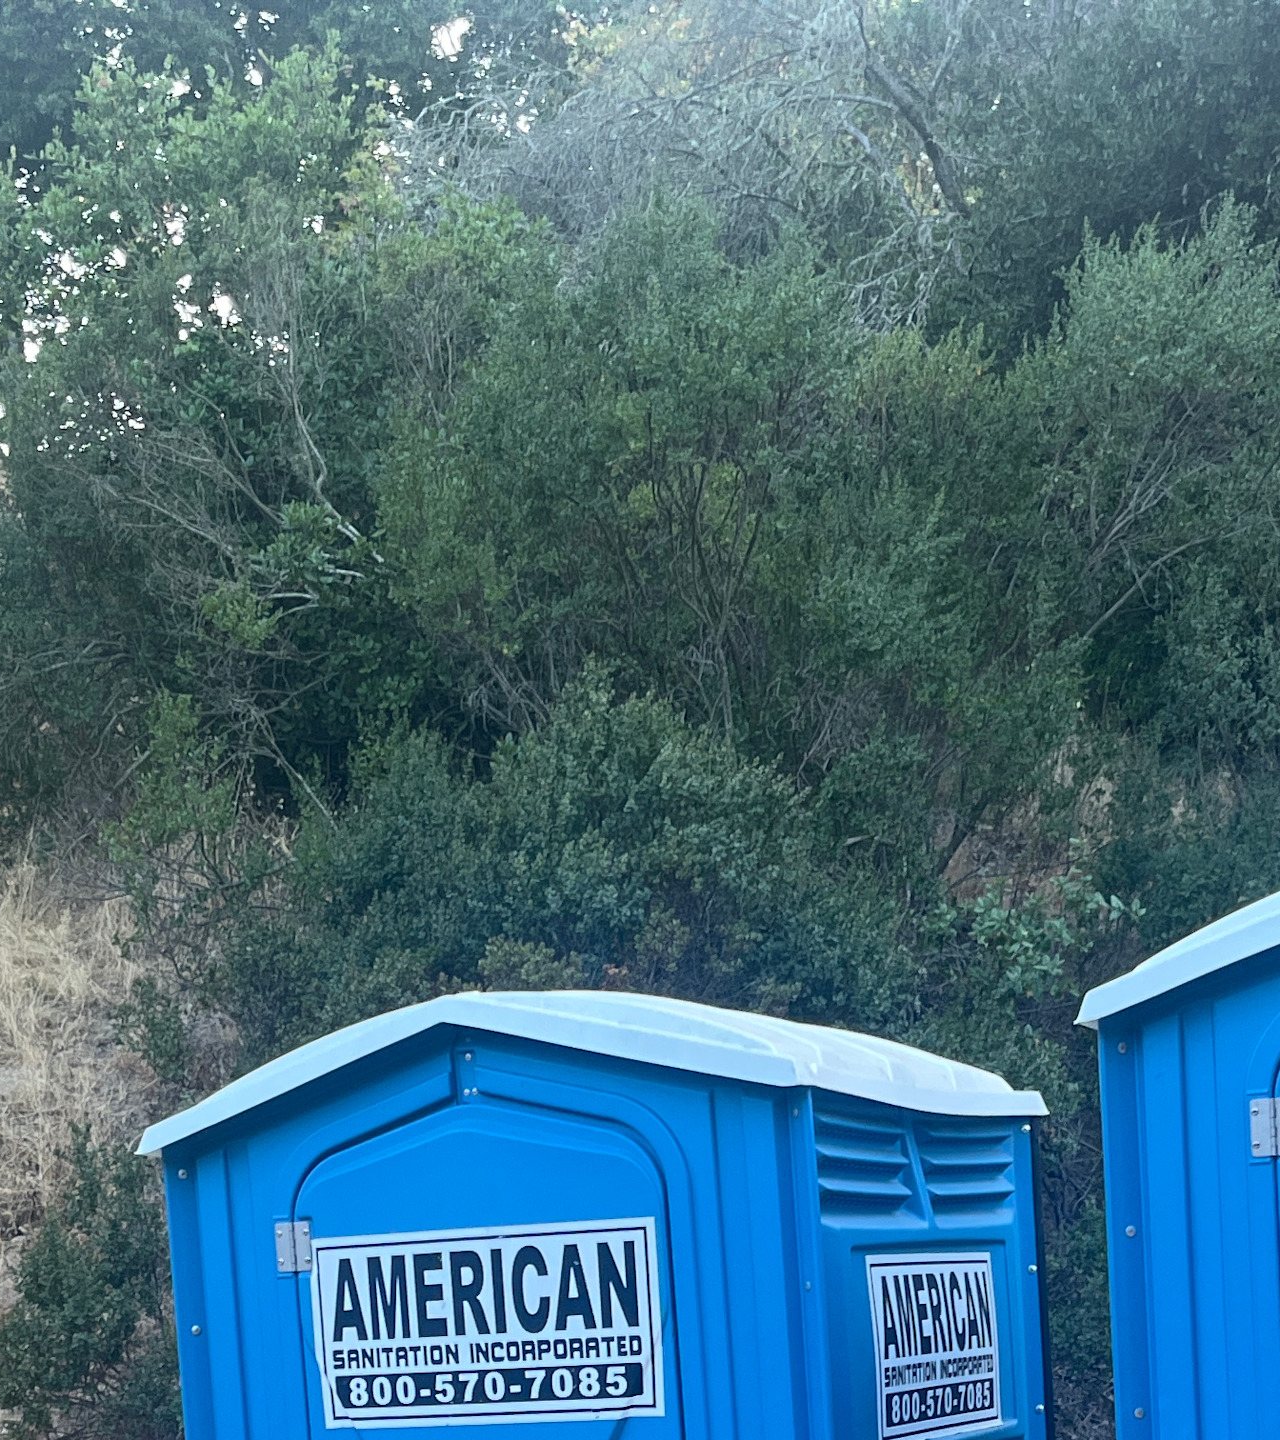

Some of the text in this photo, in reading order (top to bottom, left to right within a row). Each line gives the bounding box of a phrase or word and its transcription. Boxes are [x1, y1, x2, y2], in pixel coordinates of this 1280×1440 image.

[333, 1241, 640, 1342] AMERICAN
[881, 1271, 993, 1360] AMERICAN
[333, 1335, 642, 1370] SANITATION INCORPORATED
[885, 1354, 994, 1388] SANITATION INCORPORATED
[348, 1366, 628, 1407] 800-570-7085
[891, 1381, 991, 1423] 800-570-7085
